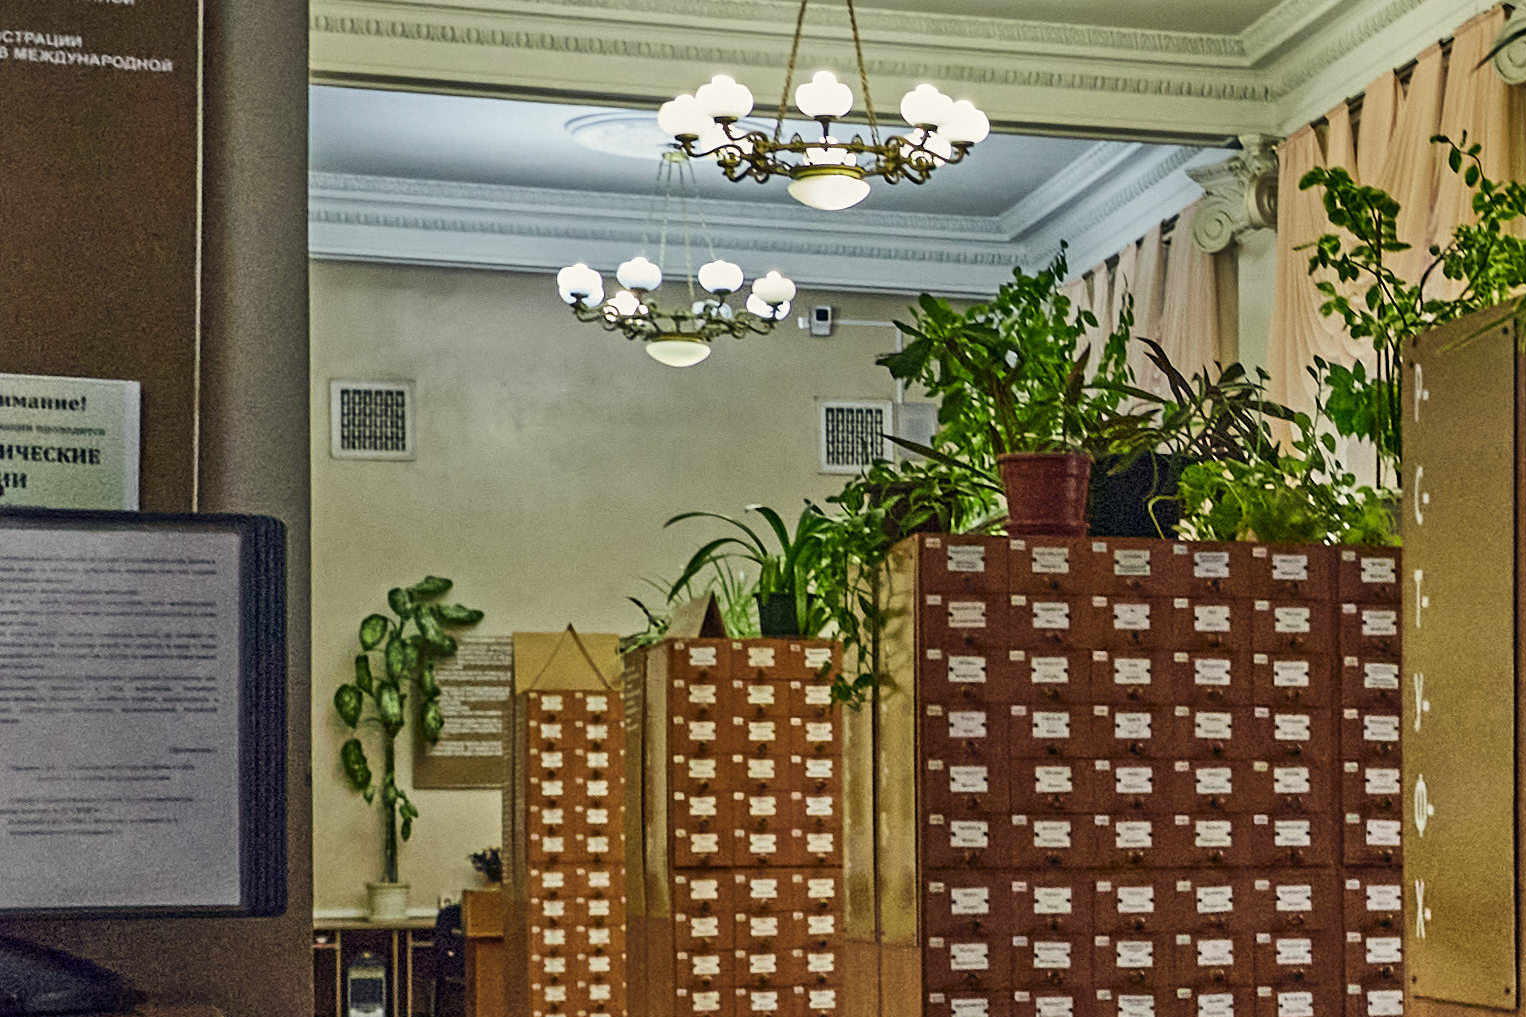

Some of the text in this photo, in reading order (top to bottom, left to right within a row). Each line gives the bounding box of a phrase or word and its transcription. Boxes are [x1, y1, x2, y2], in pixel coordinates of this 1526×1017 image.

[0, 30, 83, 48] СТРАЦИИ
[13, 47, 174, 72] МЕЖДУНАРОДНОЙ
[0, 444, 101, 465] ИЧЕСКИЕ
